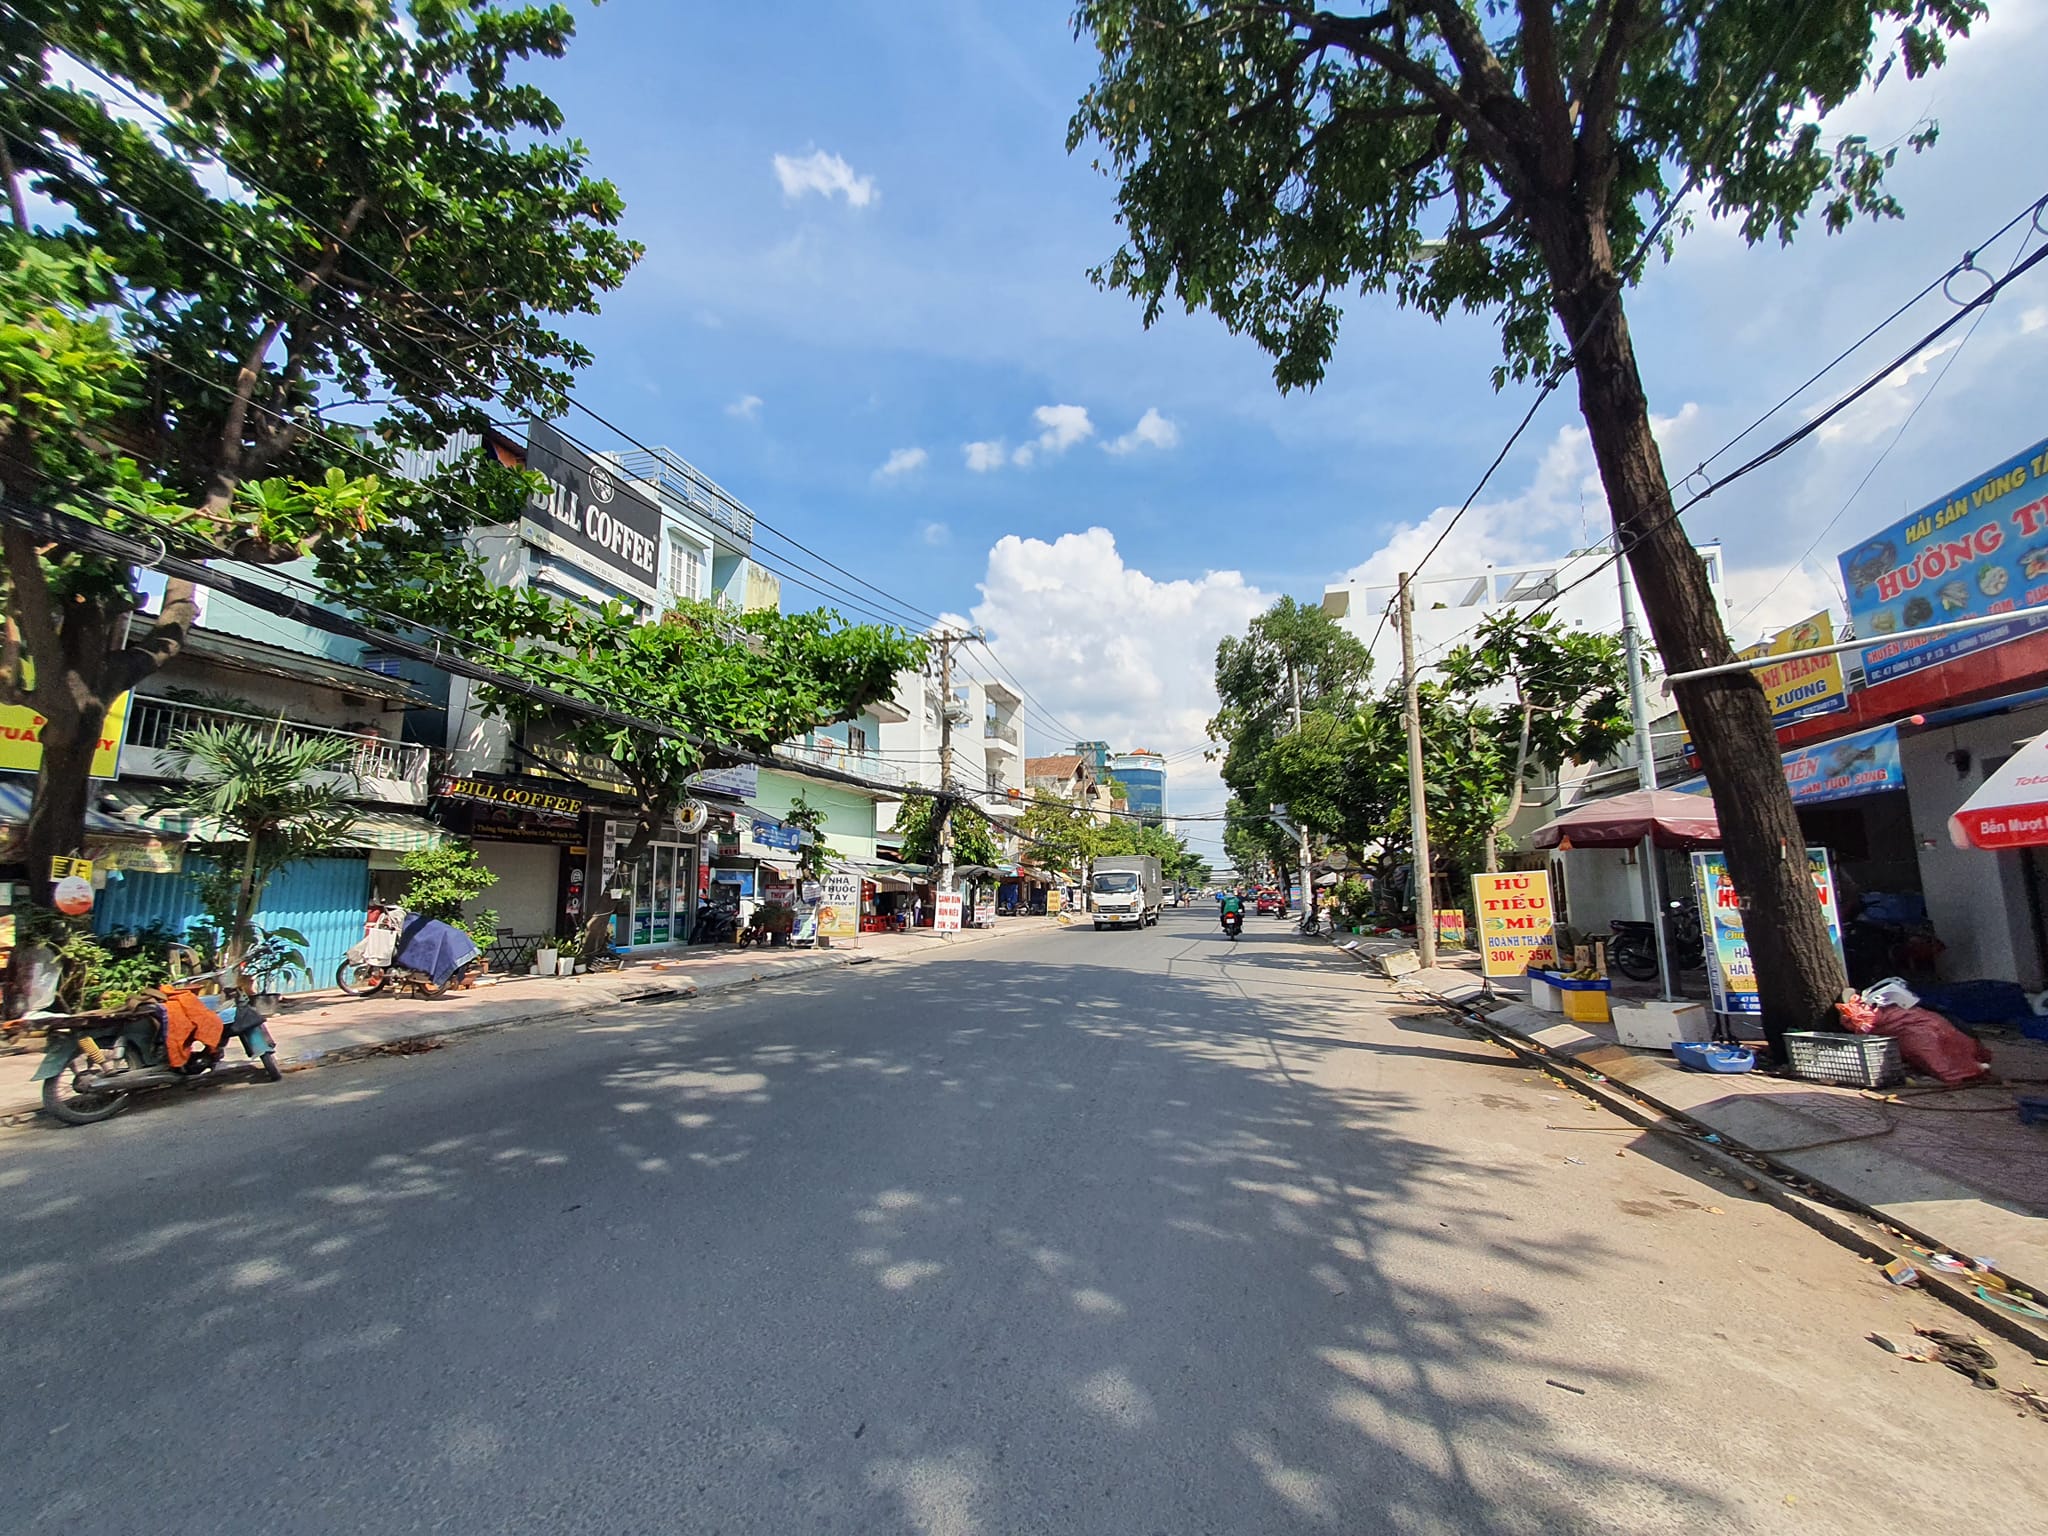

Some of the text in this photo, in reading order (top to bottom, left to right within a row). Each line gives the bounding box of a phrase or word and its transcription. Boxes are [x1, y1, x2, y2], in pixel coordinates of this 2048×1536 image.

[1904, 514, 1932, 545] HẢI
[1934, 497, 1969, 530] SẢN
[585, 504, 655, 574] COFFEE
[1875, 522, 2003, 602] HƯỜNG
[454, 780, 498, 799] BILL
[502, 788, 582, 813] COFFEE
[1494, 874, 1530, 890] HỦ
[1484, 893, 1545, 911] TIẾU
[1505, 915, 1535, 930] MÌ
[1490, 950, 1516, 962] 30K
[1527, 949, 1553, 961] 35K
